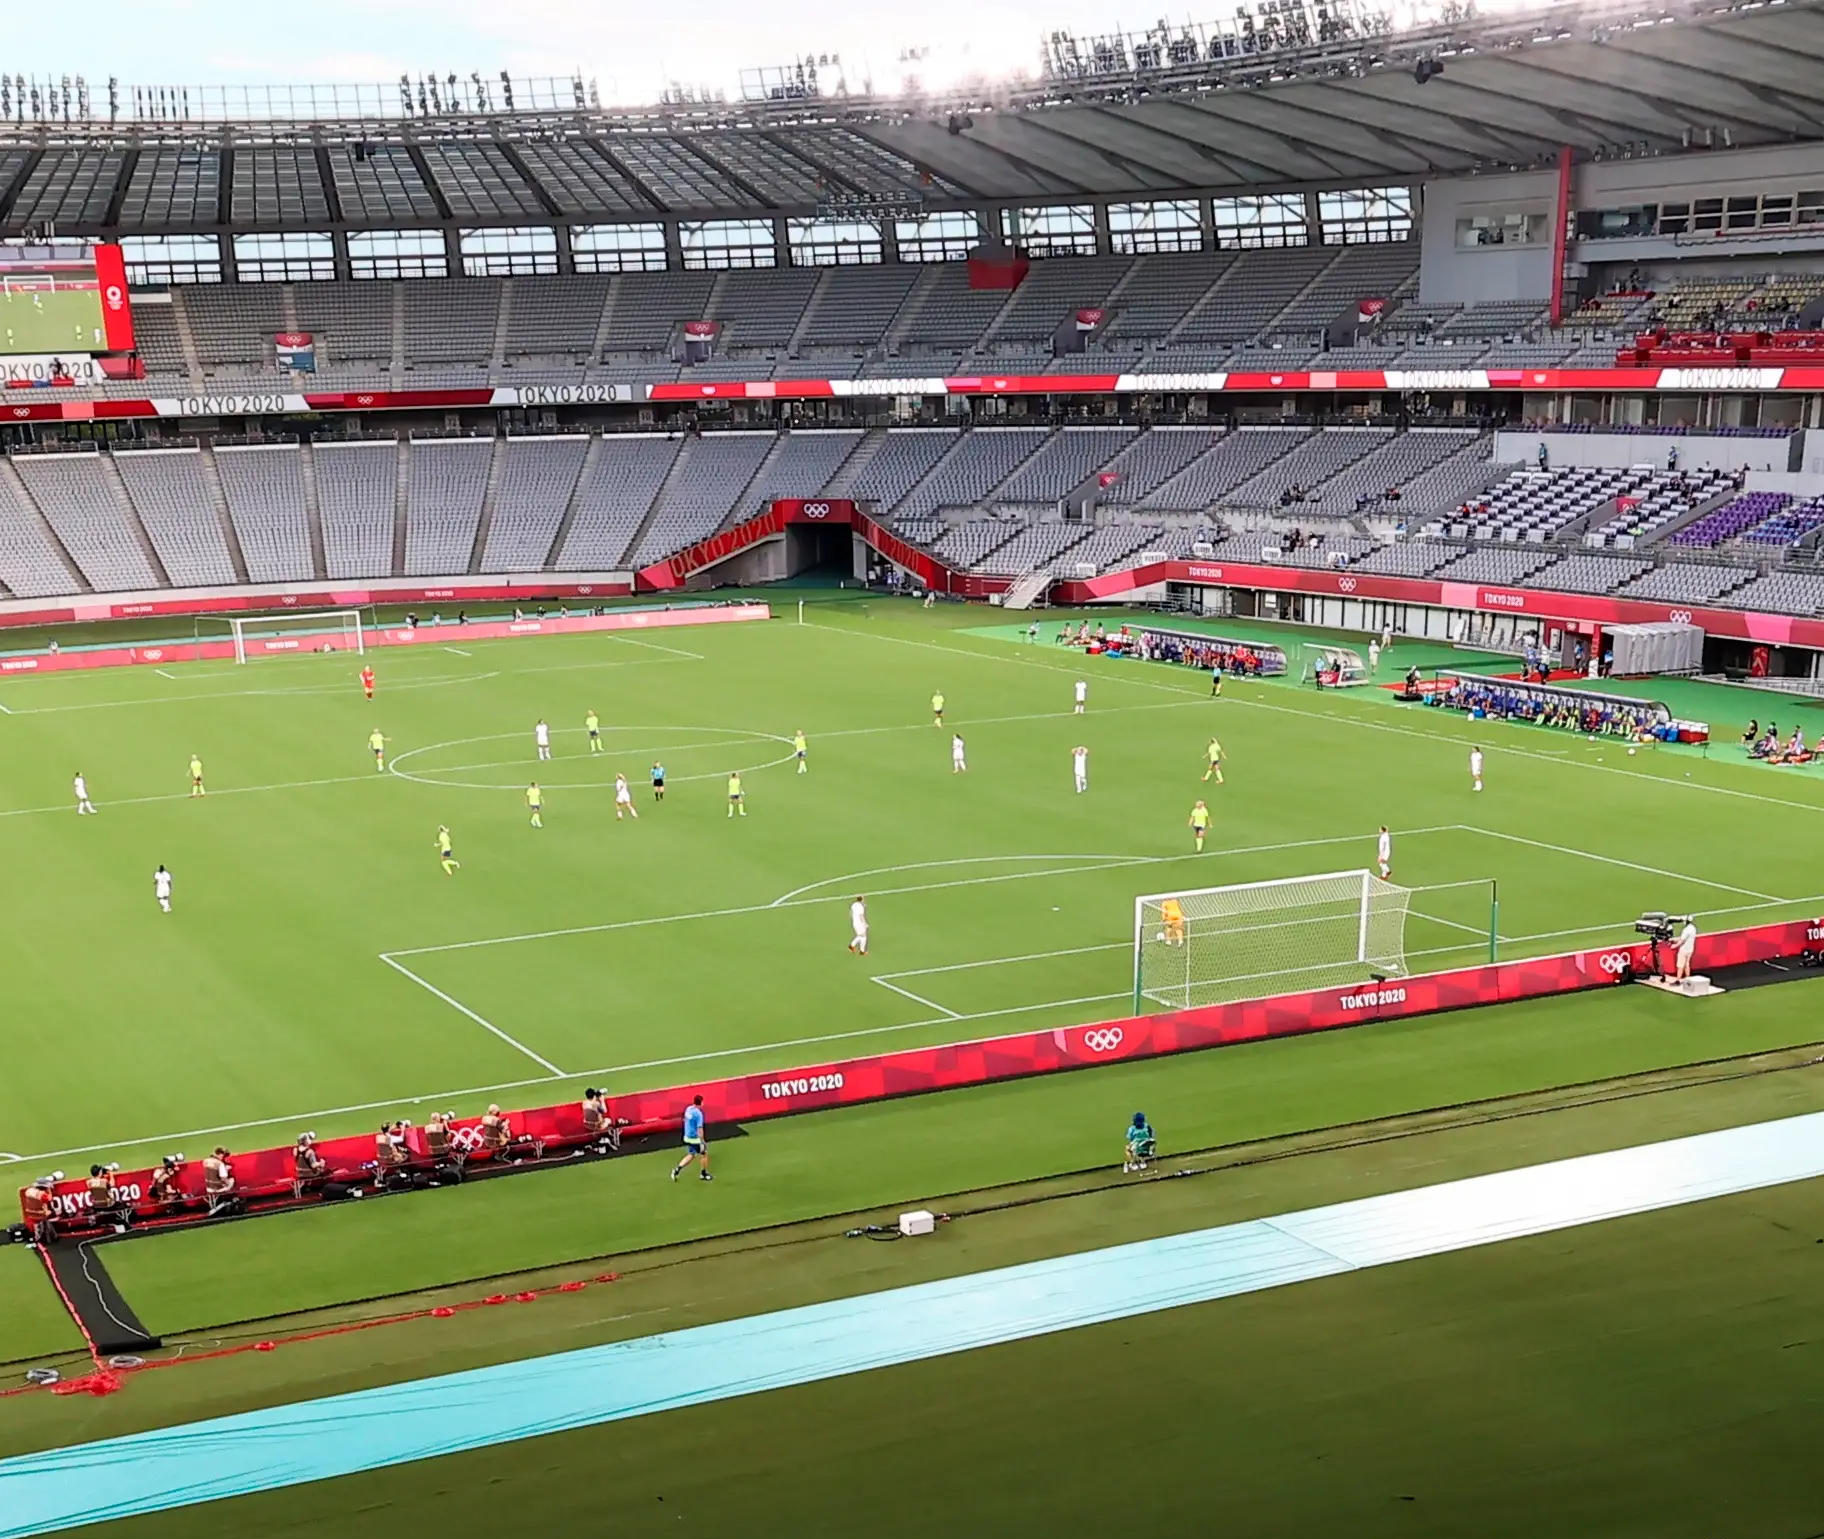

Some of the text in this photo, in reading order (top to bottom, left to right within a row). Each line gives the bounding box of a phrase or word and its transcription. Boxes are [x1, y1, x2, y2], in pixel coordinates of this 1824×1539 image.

[514, 384, 617, 404] TOKYO 2020
[178, 394, 285, 415] TOKYO 2020
[1188, 566, 1223, 578] TOKYO 2020
[1483, 592, 1524, 606] TOKYO 2020
[1340, 988, 1406, 1010] TOKYO 2020
[762, 1075, 843, 1098] TOKYO 2020
[110, 1183, 141, 1202] 020
